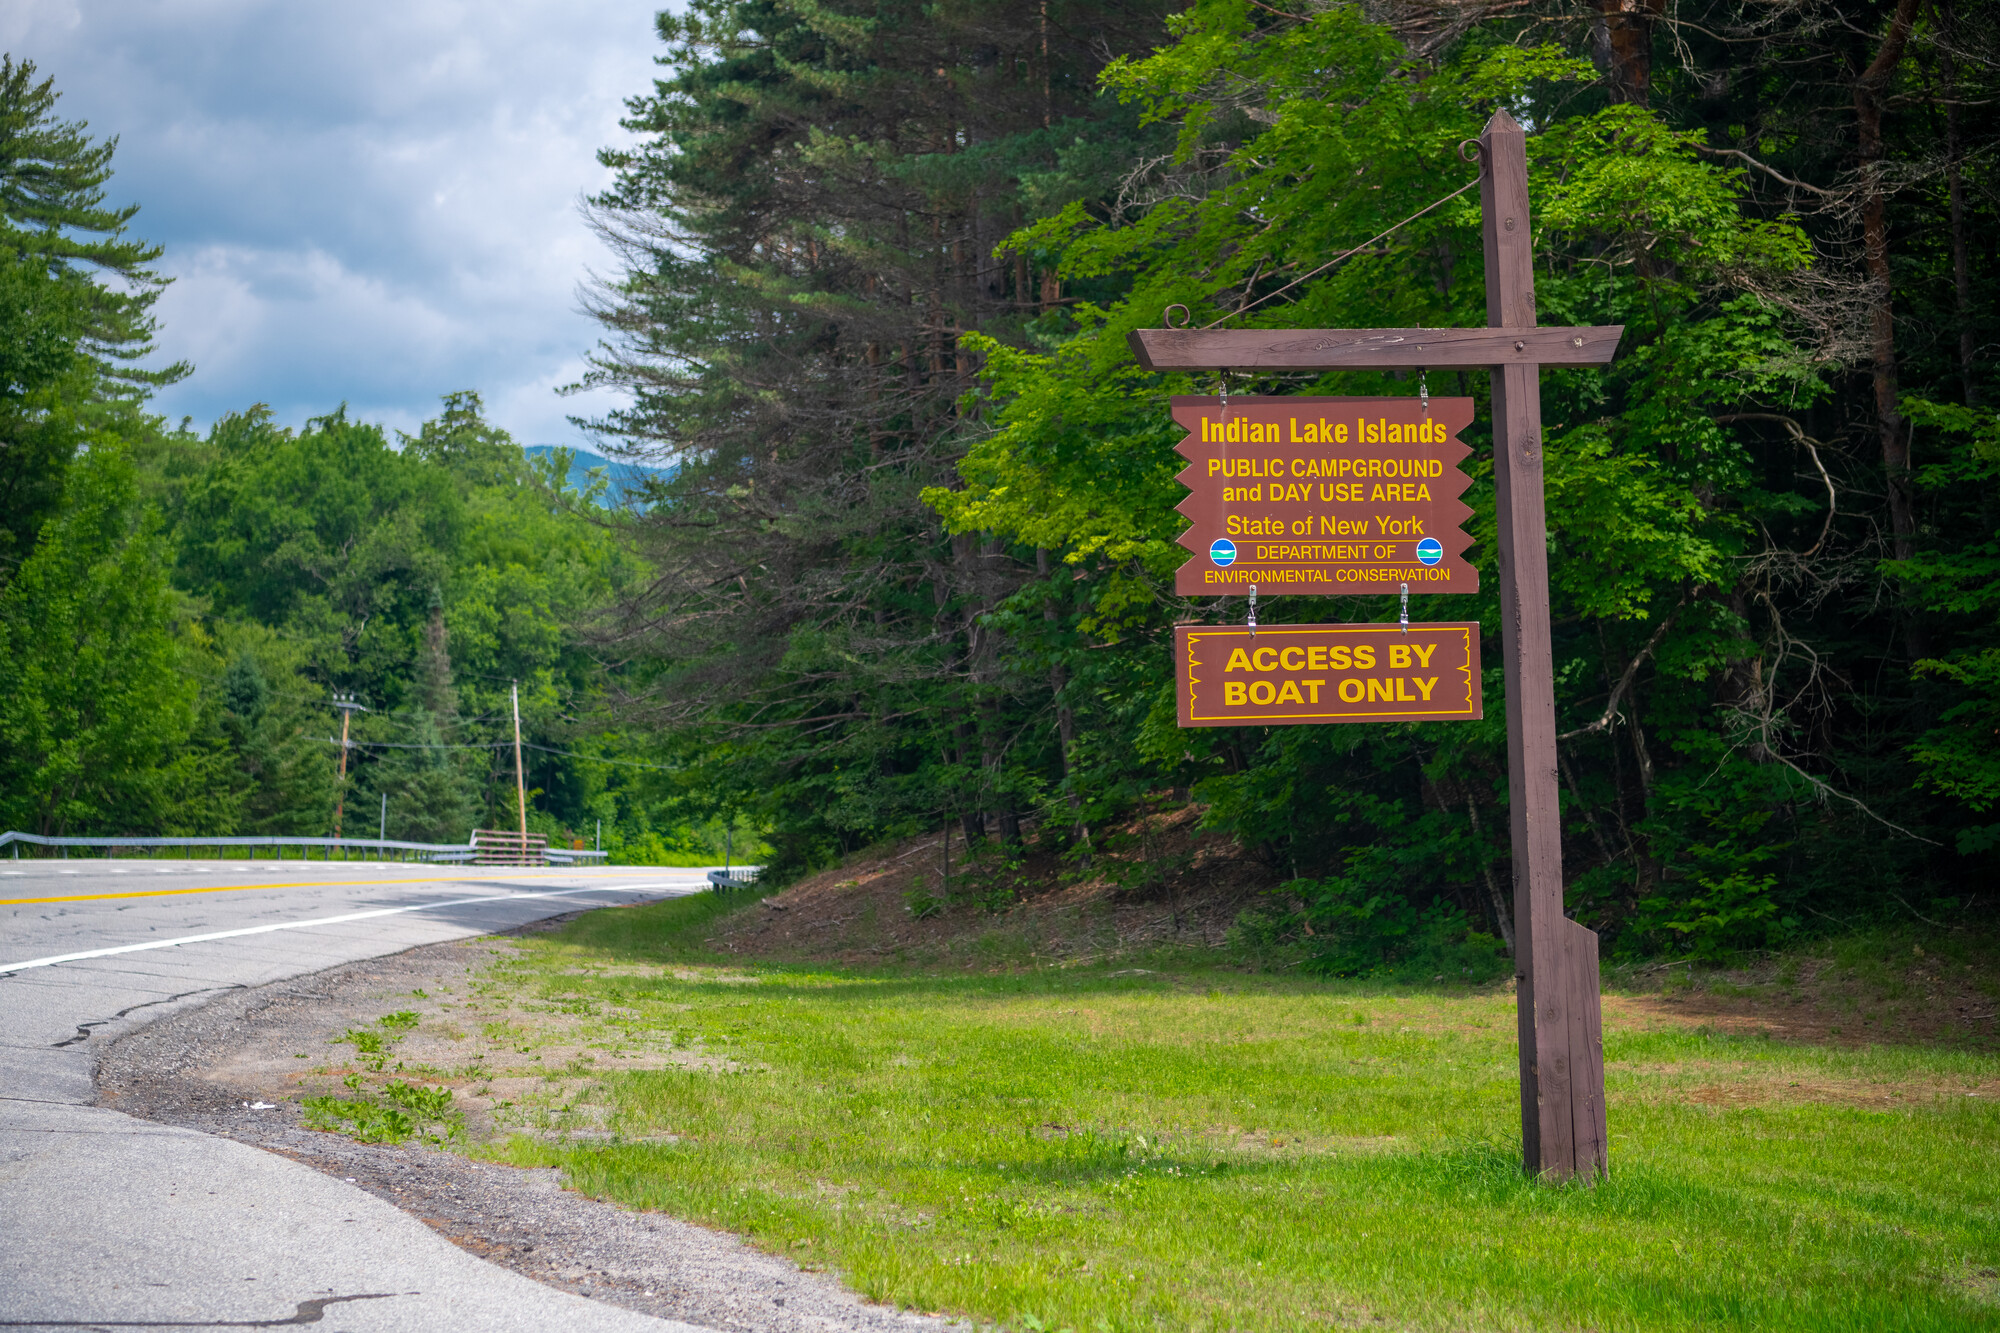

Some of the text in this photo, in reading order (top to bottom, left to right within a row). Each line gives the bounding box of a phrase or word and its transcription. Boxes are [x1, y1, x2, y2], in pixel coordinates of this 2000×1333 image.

[1200, 416, 1448, 444] Indian Lake Islands
[1207, 457, 1443, 478] PUBLIC CAMPGROUND
[1222, 482, 1432, 503] and DAY USE AREA
[1225, 514, 1425, 536] State of New York
[1256, 544, 1397, 560] DEPARTMENT OF
[1204, 567, 1451, 584] ENVIRONMENTAL CONSERVATION
[1223, 643, 1438, 673] ACCESS BY
[1223, 676, 1440, 707] BOAT ONLY
